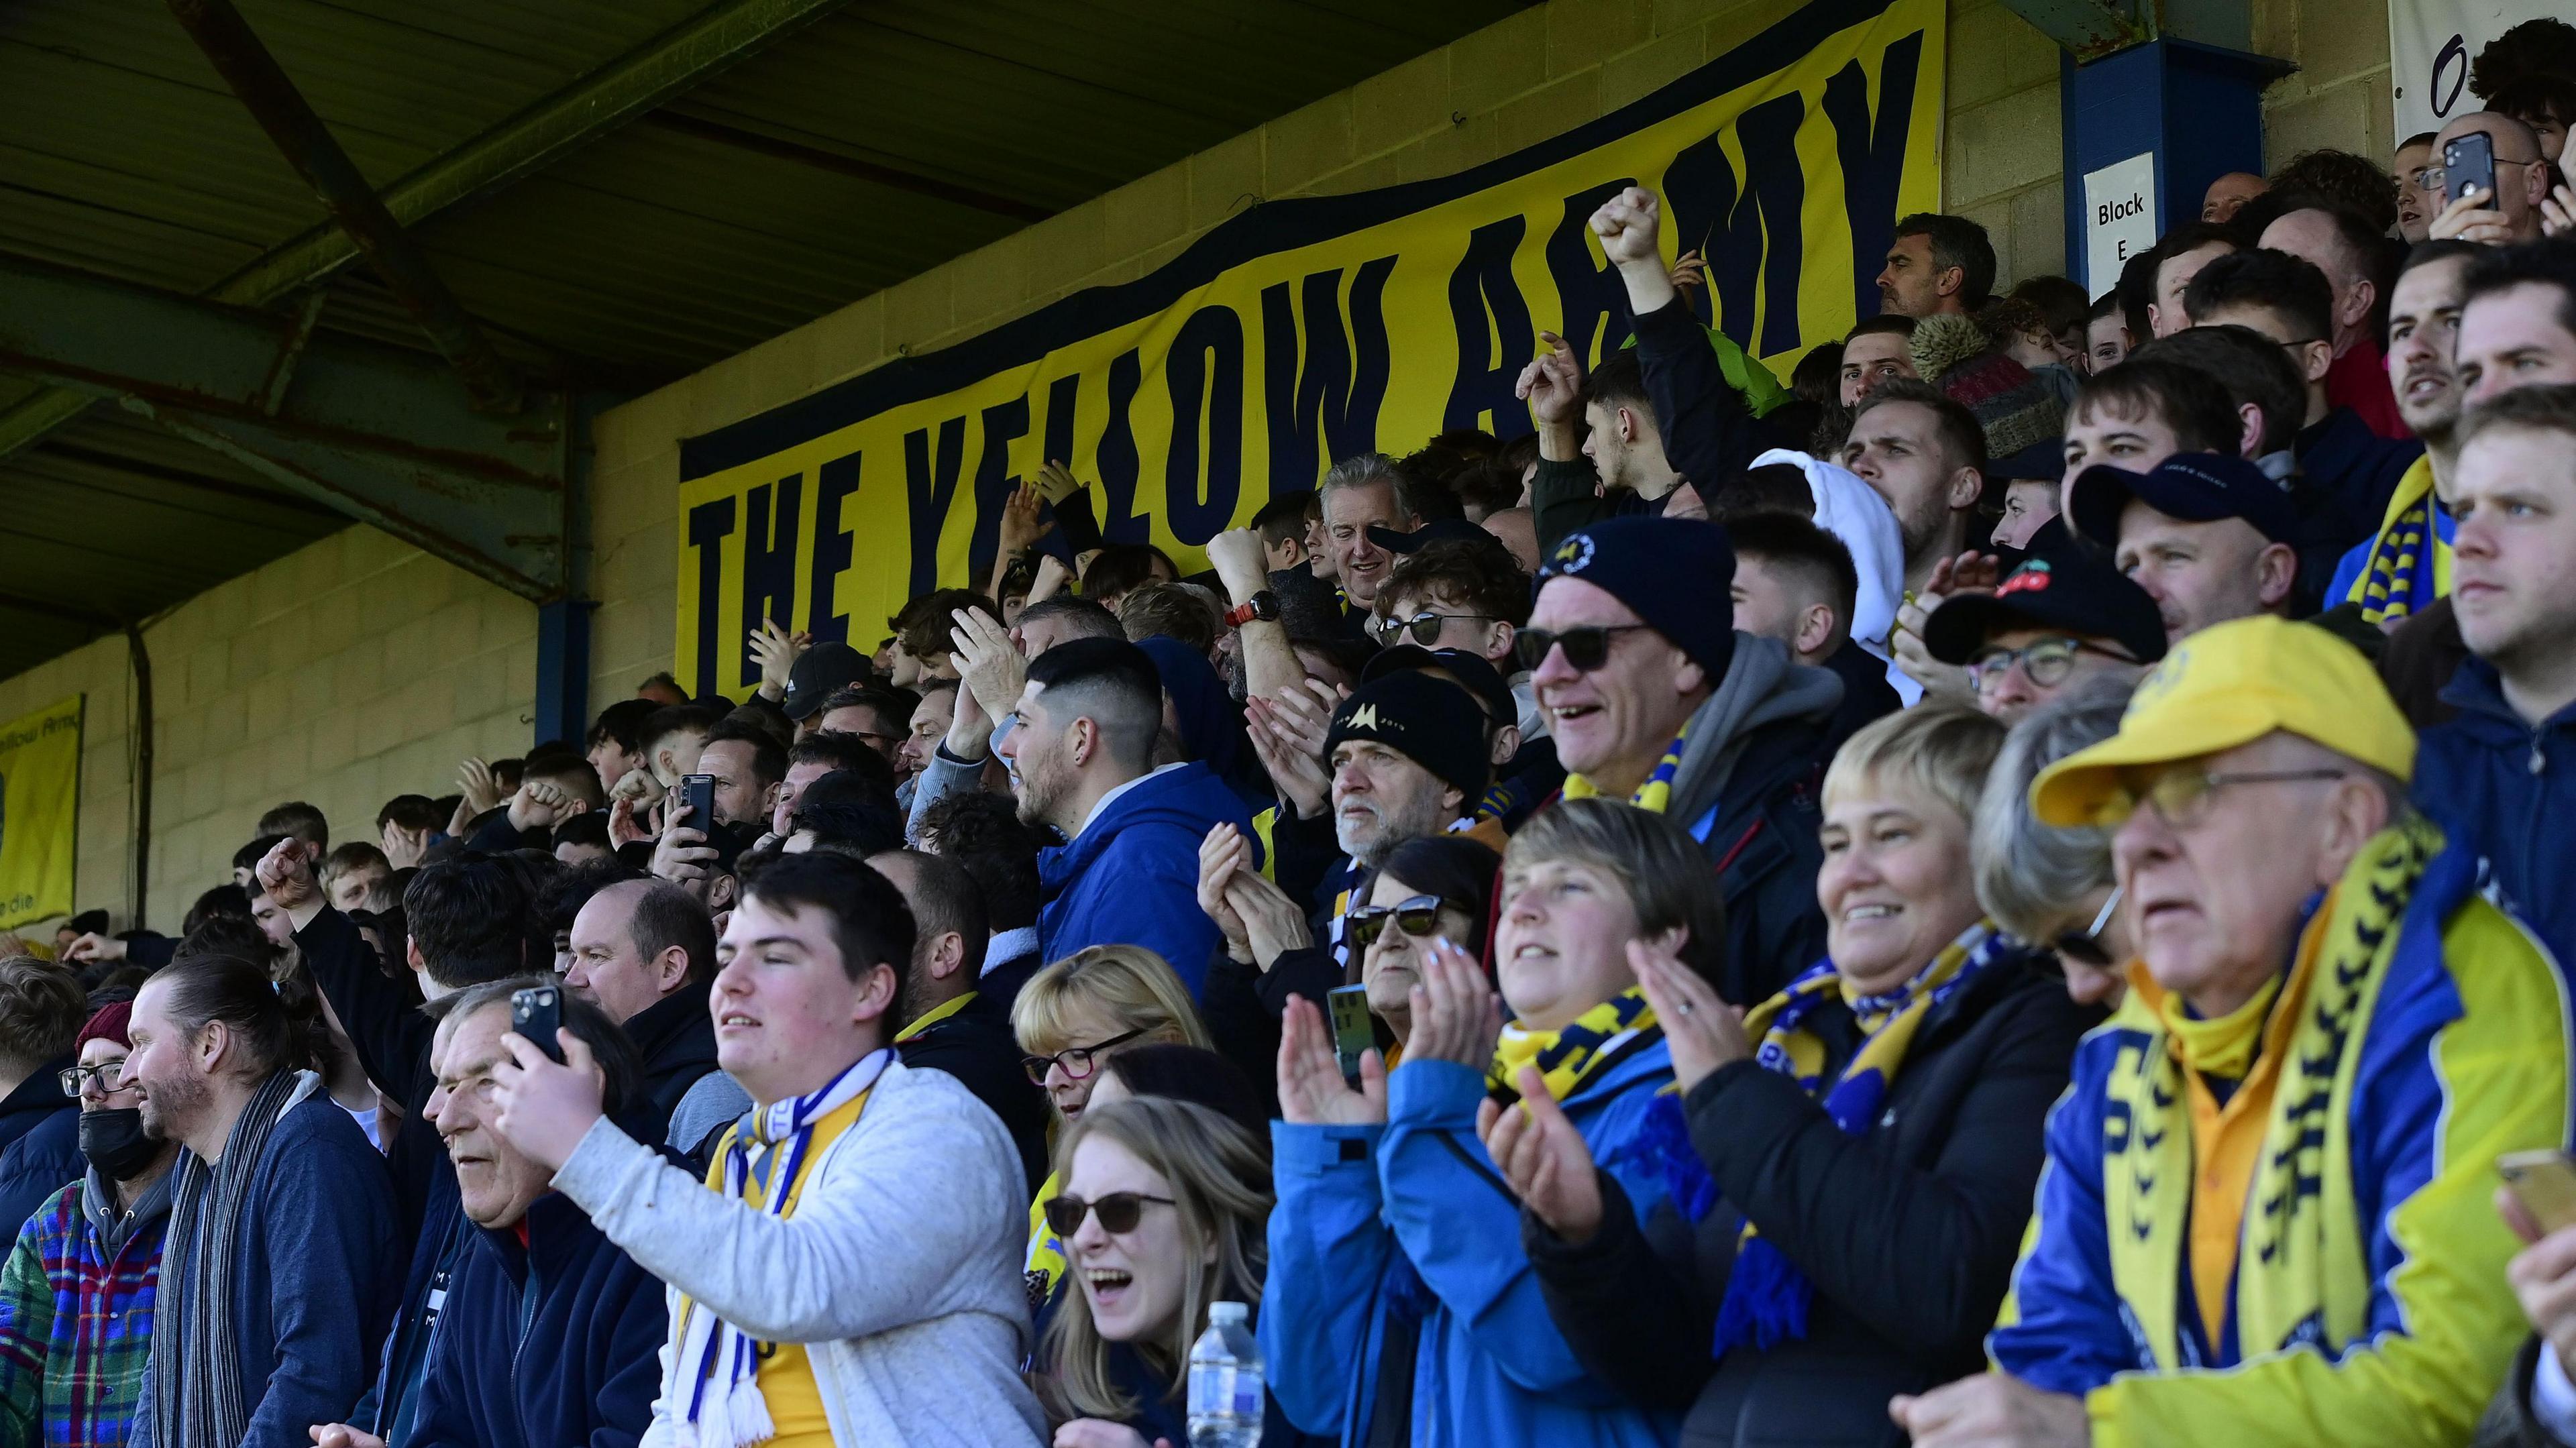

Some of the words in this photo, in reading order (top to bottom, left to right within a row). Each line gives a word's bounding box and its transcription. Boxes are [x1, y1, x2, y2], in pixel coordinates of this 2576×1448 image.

[2098, 192, 2144, 226] Block
[2118, 239, 2127, 261] E
[689, 450, 862, 699] THE
[904, 254, 1400, 602] YELLOW
